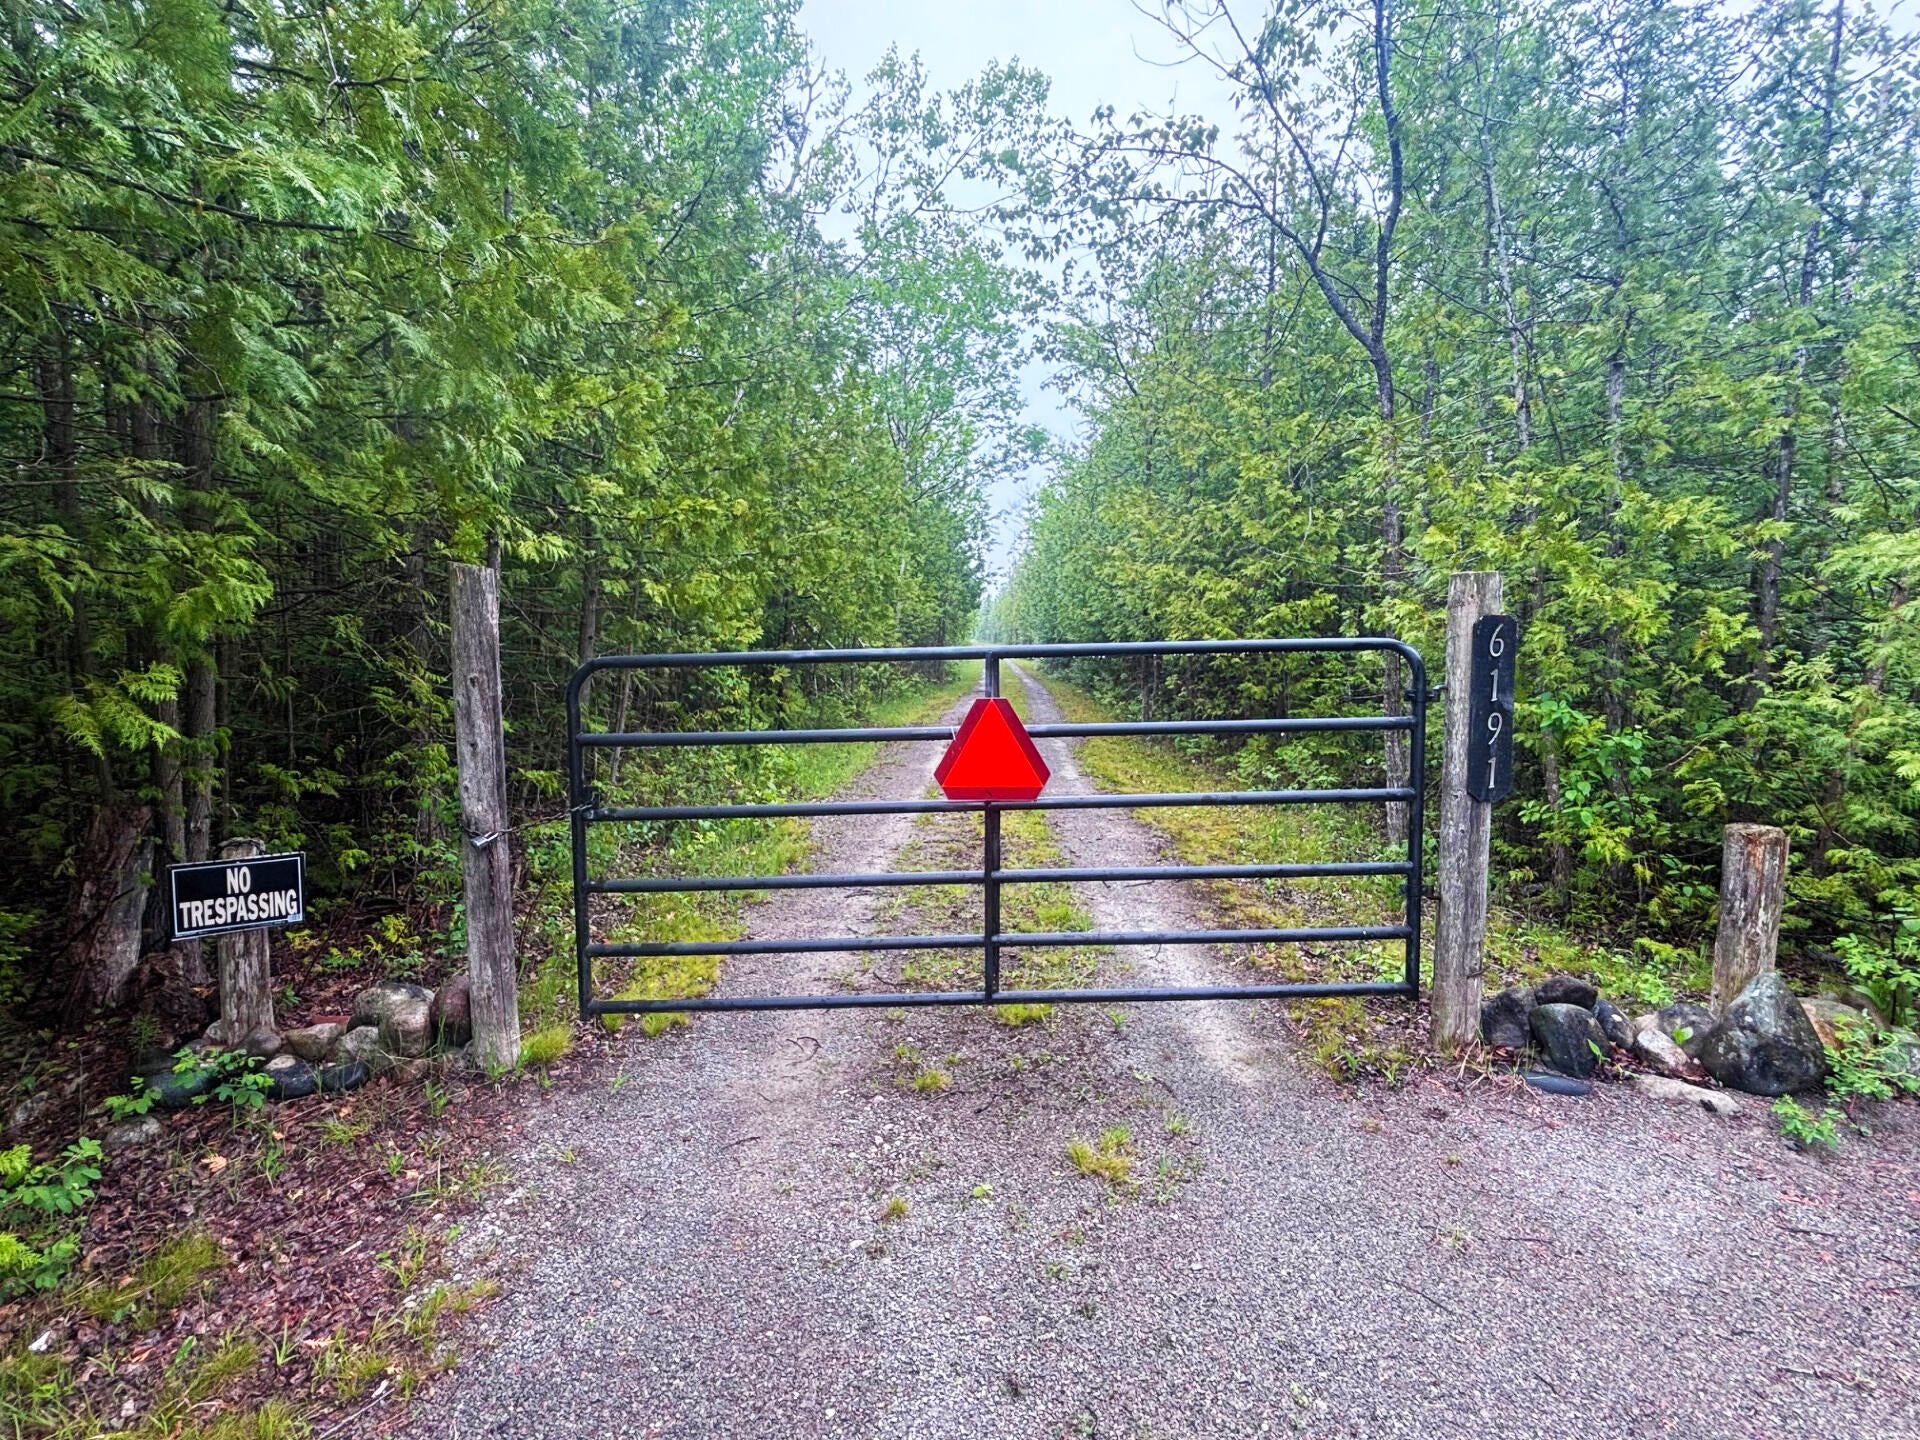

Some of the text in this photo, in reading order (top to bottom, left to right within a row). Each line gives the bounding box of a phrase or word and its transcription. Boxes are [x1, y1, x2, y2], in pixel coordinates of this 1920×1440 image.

[1487, 623, 1504, 789] 6191
[226, 866, 251, 895] NO
[179, 889, 297, 928] TRESPASSING
